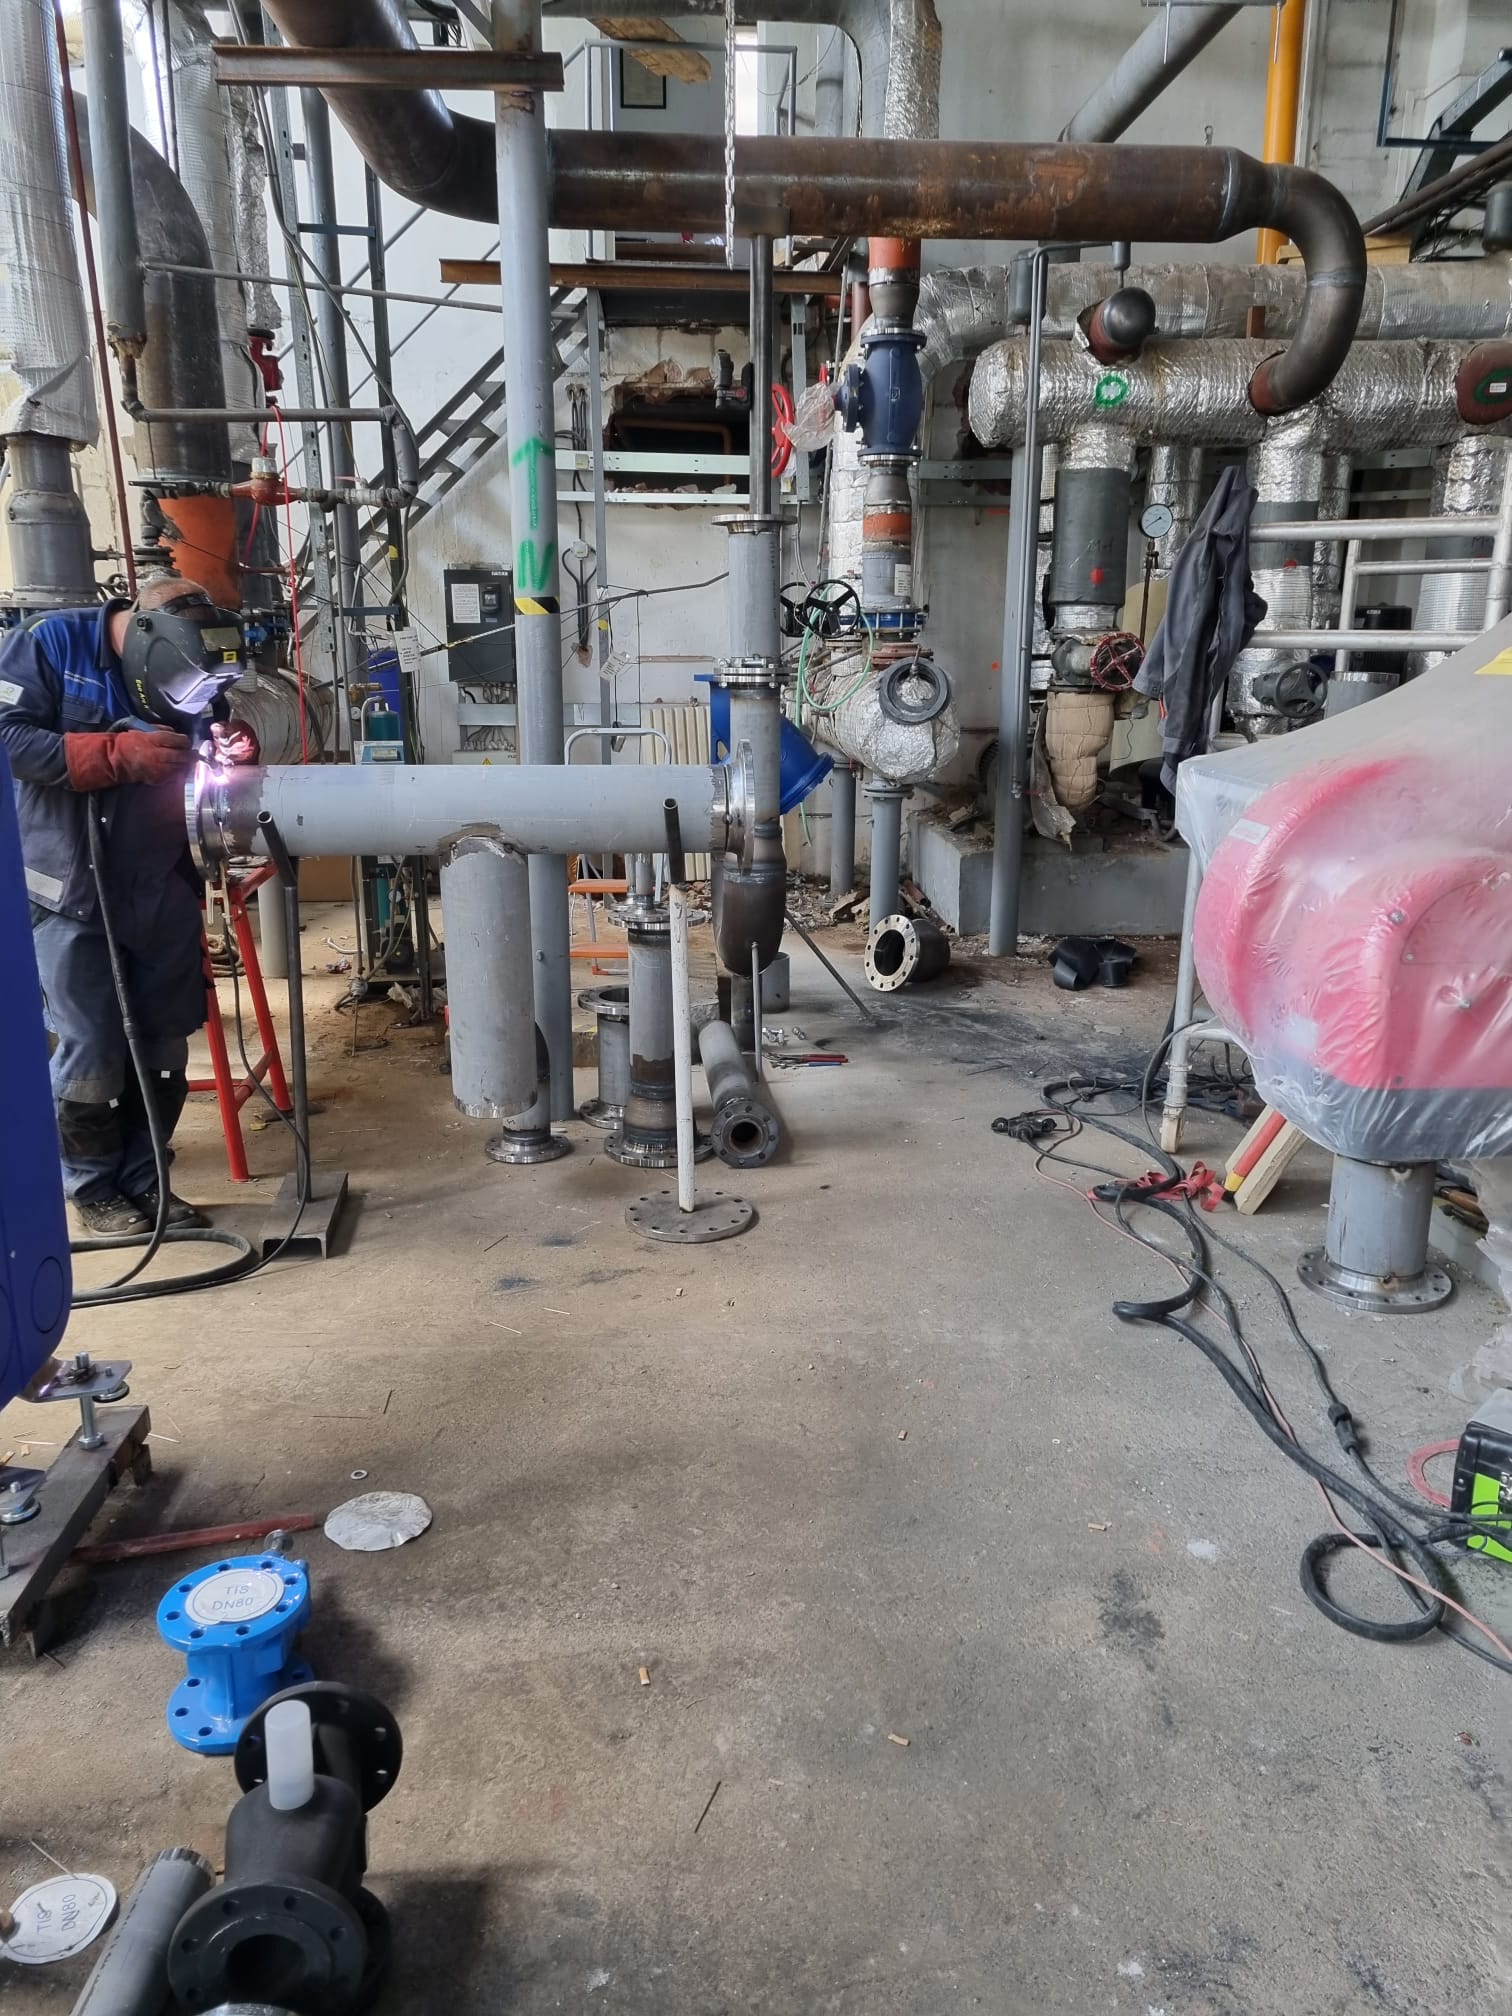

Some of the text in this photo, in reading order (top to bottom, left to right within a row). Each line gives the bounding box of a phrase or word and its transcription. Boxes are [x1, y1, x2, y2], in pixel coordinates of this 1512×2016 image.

[225, 1585, 249, 1595] TIS
[212, 1597, 254, 1610] DN80
[61, 1894, 77, 1931] DN80
